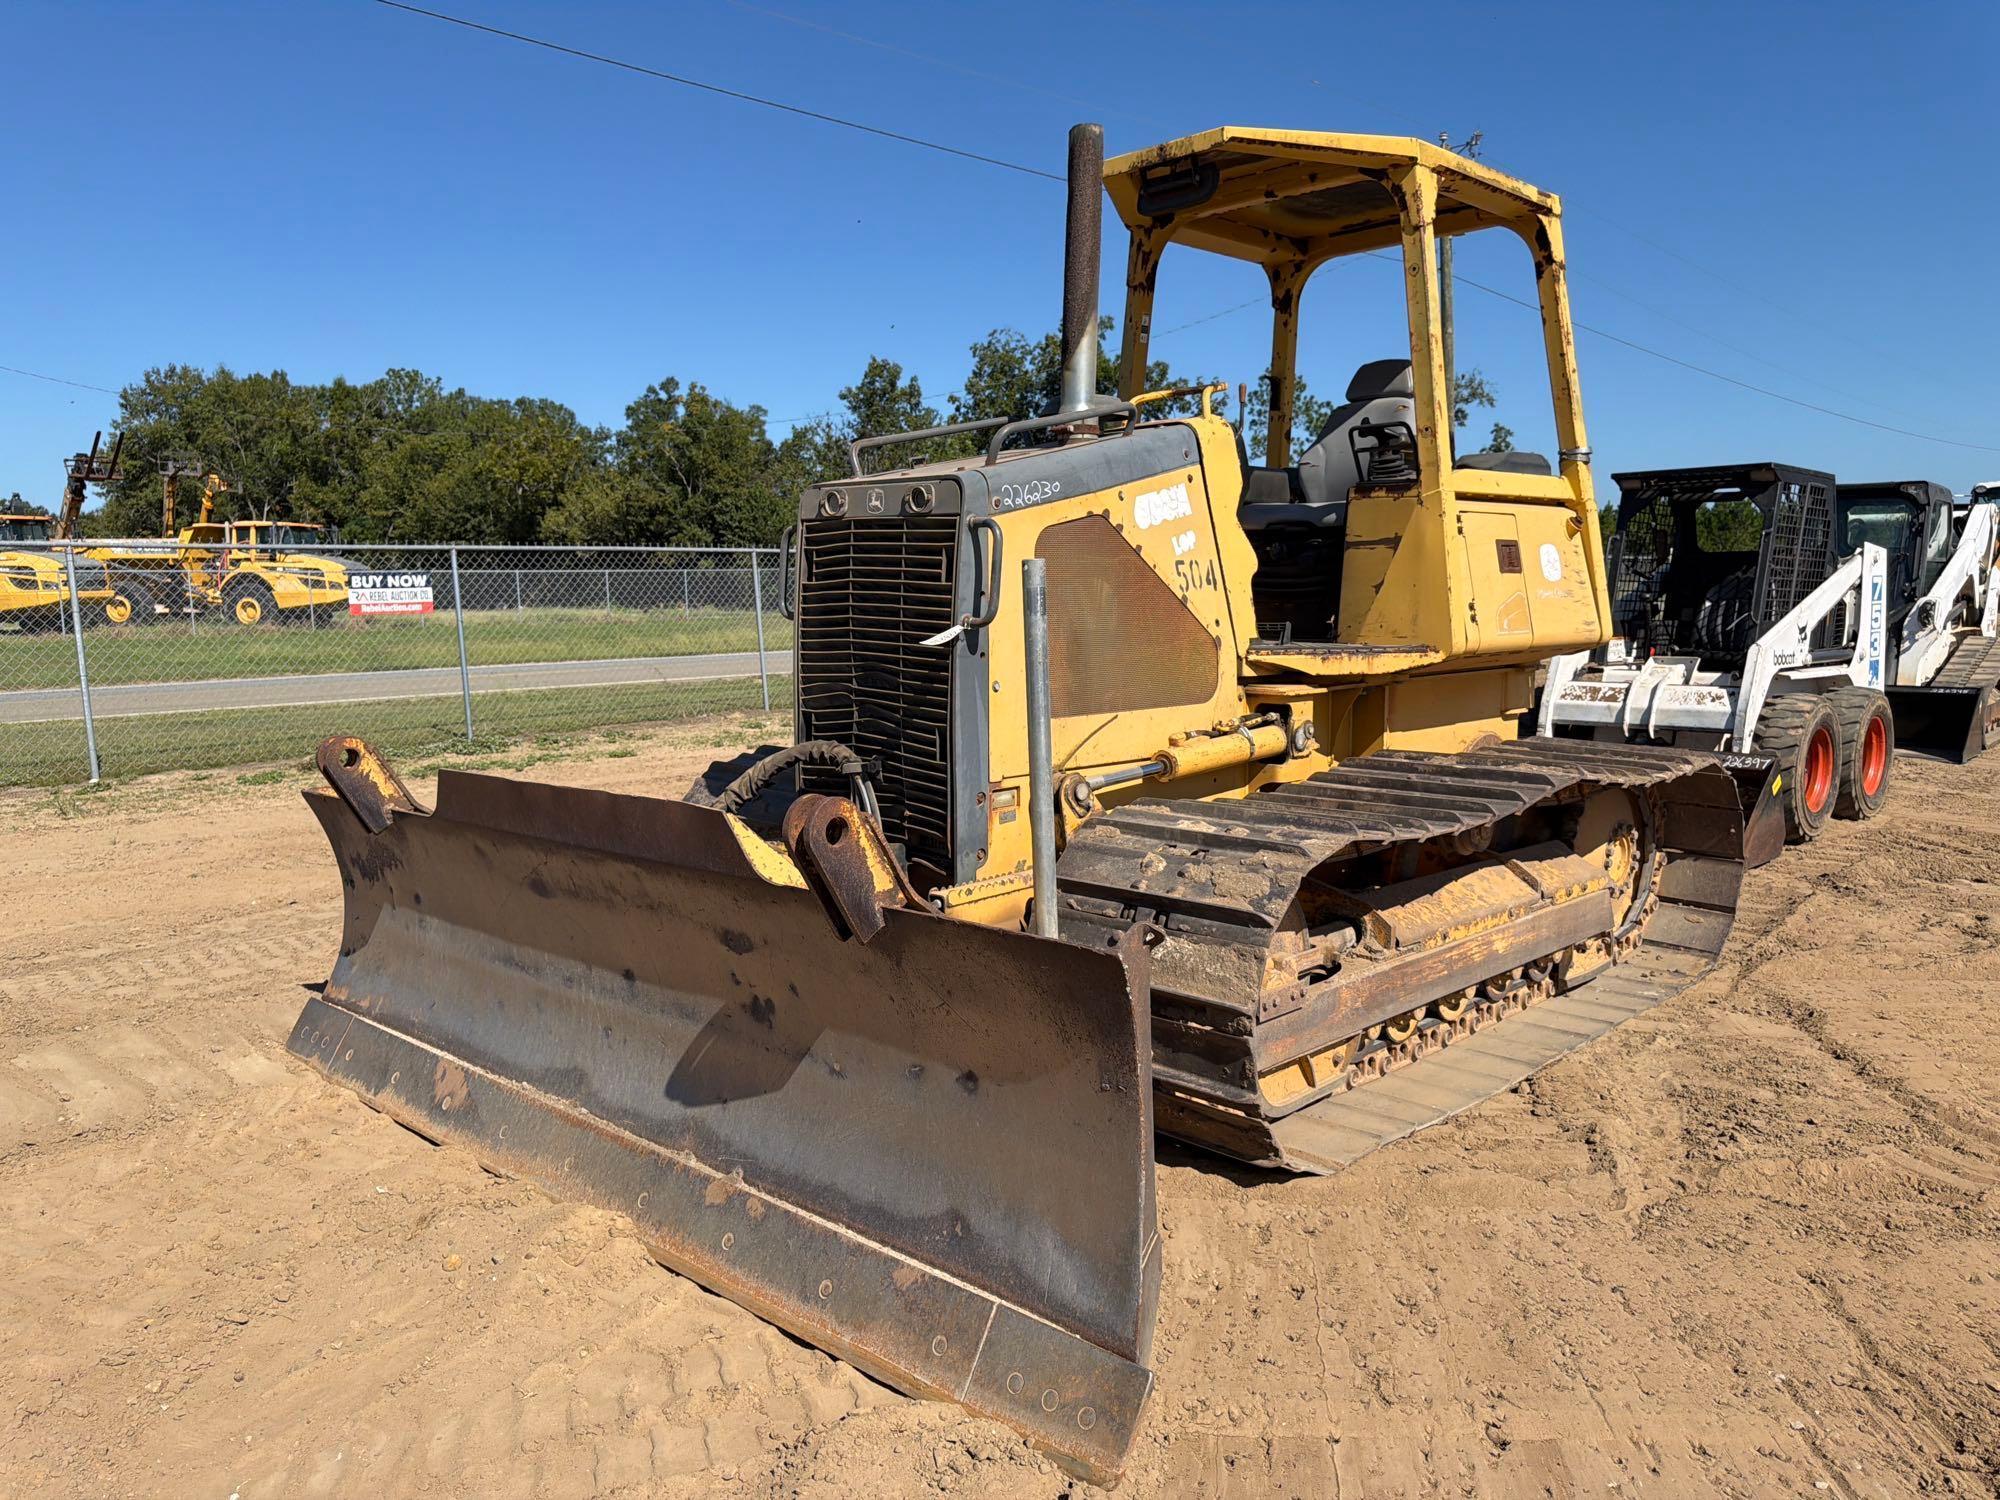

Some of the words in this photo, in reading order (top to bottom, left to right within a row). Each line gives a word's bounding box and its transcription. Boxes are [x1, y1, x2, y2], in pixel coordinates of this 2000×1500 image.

[1001, 480, 1060, 508] 226230
[351, 575, 383, 588] BUY
[387, 575, 427, 588] NOW
[1175, 559, 1217, 592] 504
[369, 591, 388, 601] REBEL
[390, 590, 417, 601] AUCTION
[1773, 649, 1795, 666] bobcat
[1723, 755, 1771, 770] 226397
